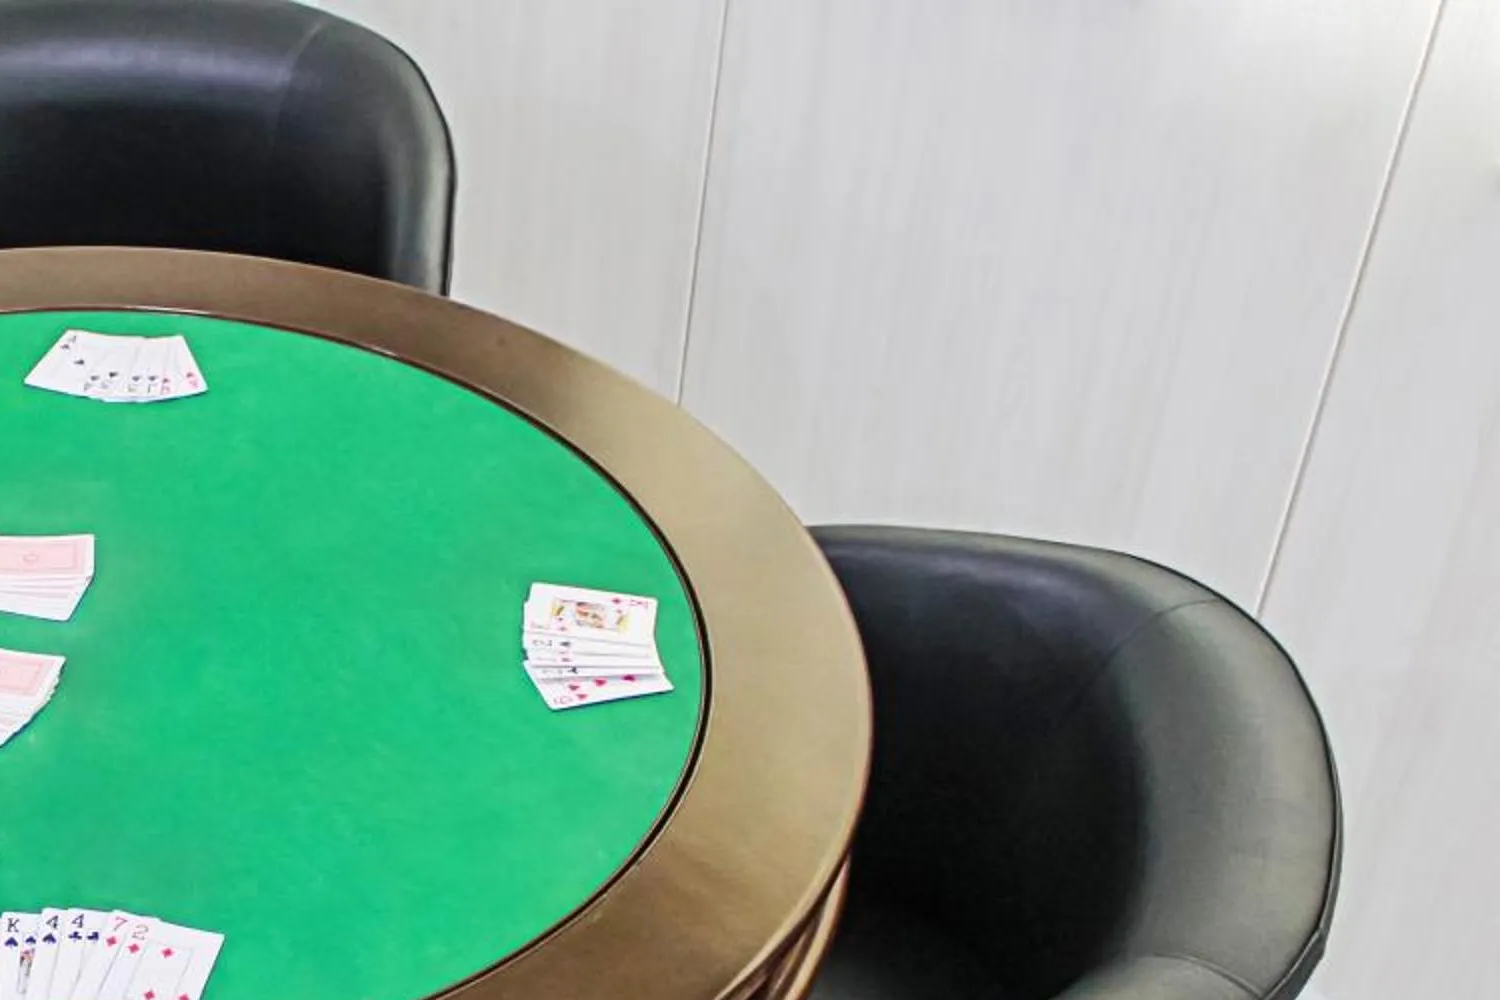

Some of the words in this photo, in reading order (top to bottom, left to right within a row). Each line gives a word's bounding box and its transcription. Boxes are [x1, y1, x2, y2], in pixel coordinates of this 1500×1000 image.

[7, 917, 21, 933] K
[45, 914, 60, 930] 4
[71, 913, 86, 929] 4
[114, 916, 129, 932] 7
[132, 924, 150, 941] 2
